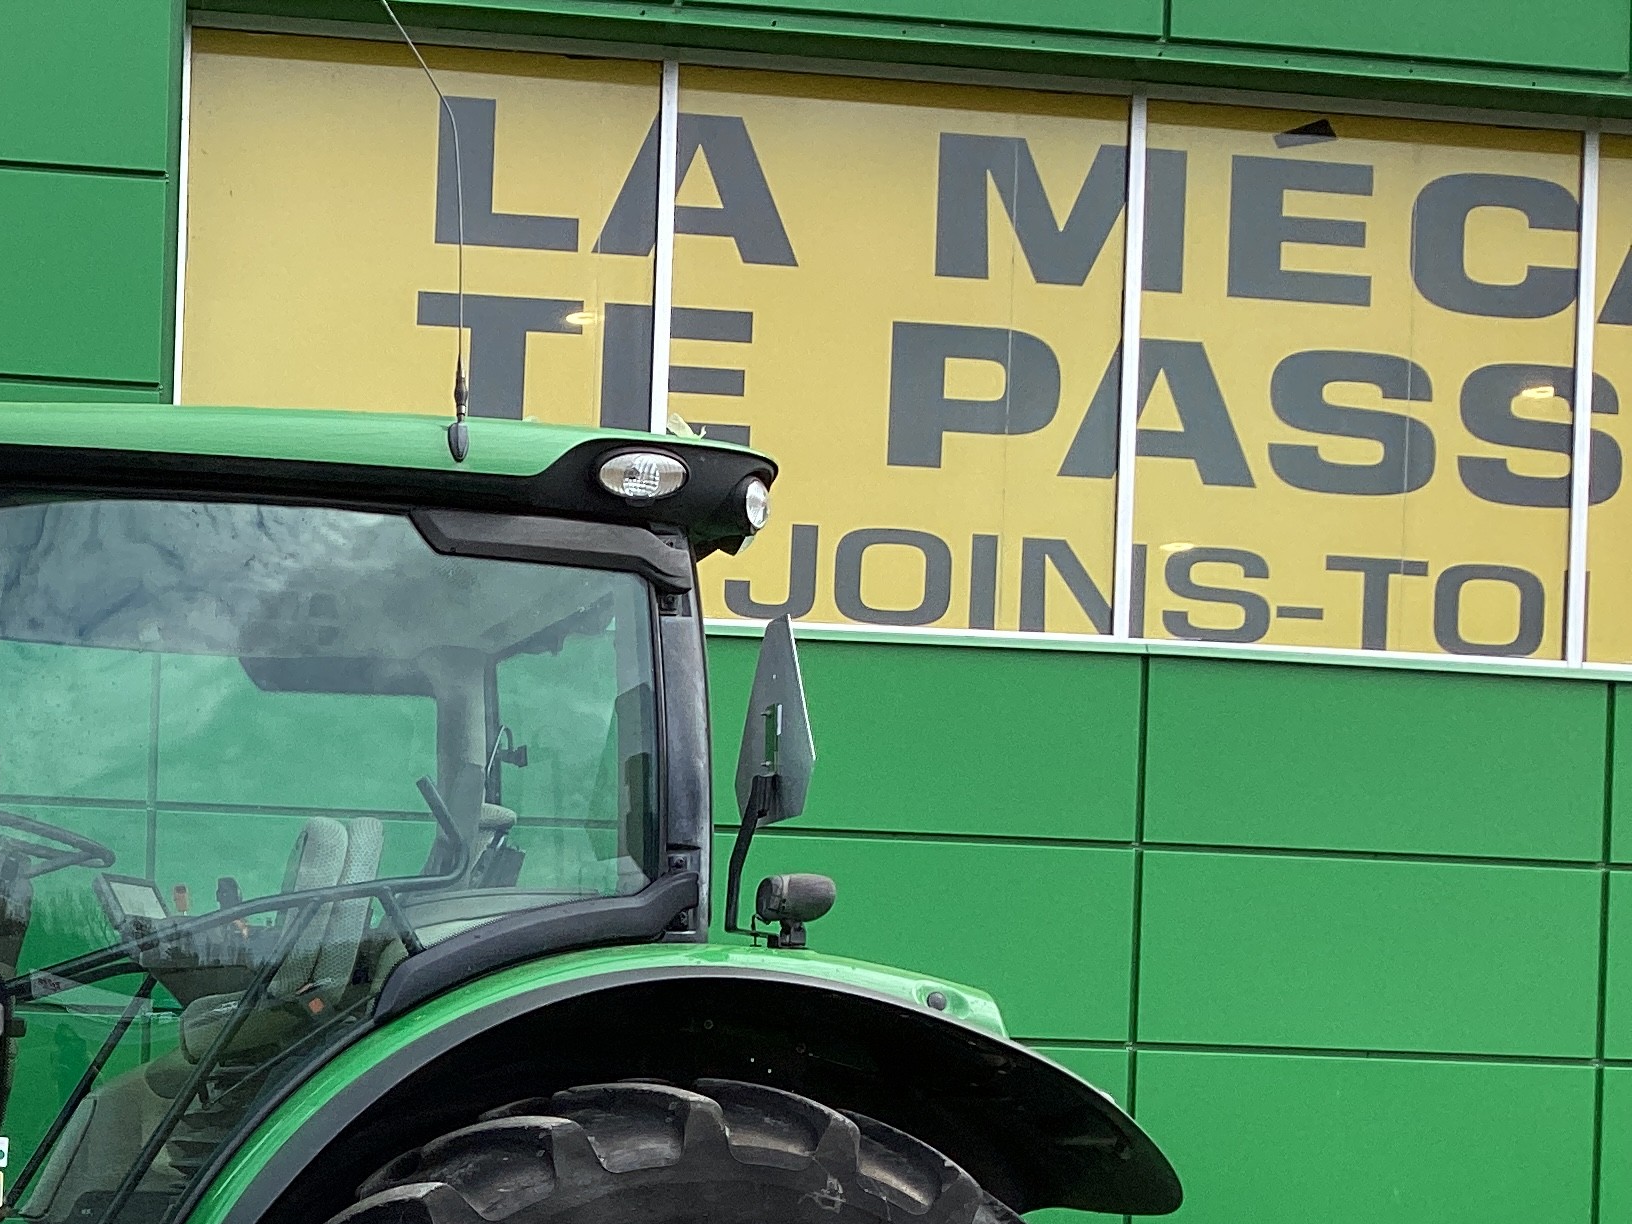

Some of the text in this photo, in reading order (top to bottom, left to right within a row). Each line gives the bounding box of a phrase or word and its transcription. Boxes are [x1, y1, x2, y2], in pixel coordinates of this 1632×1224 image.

[434, 96, 799, 267] LA
[417, 291, 1623, 508] TE PASS
[724, 524, 1590, 662] JOINS-TO
